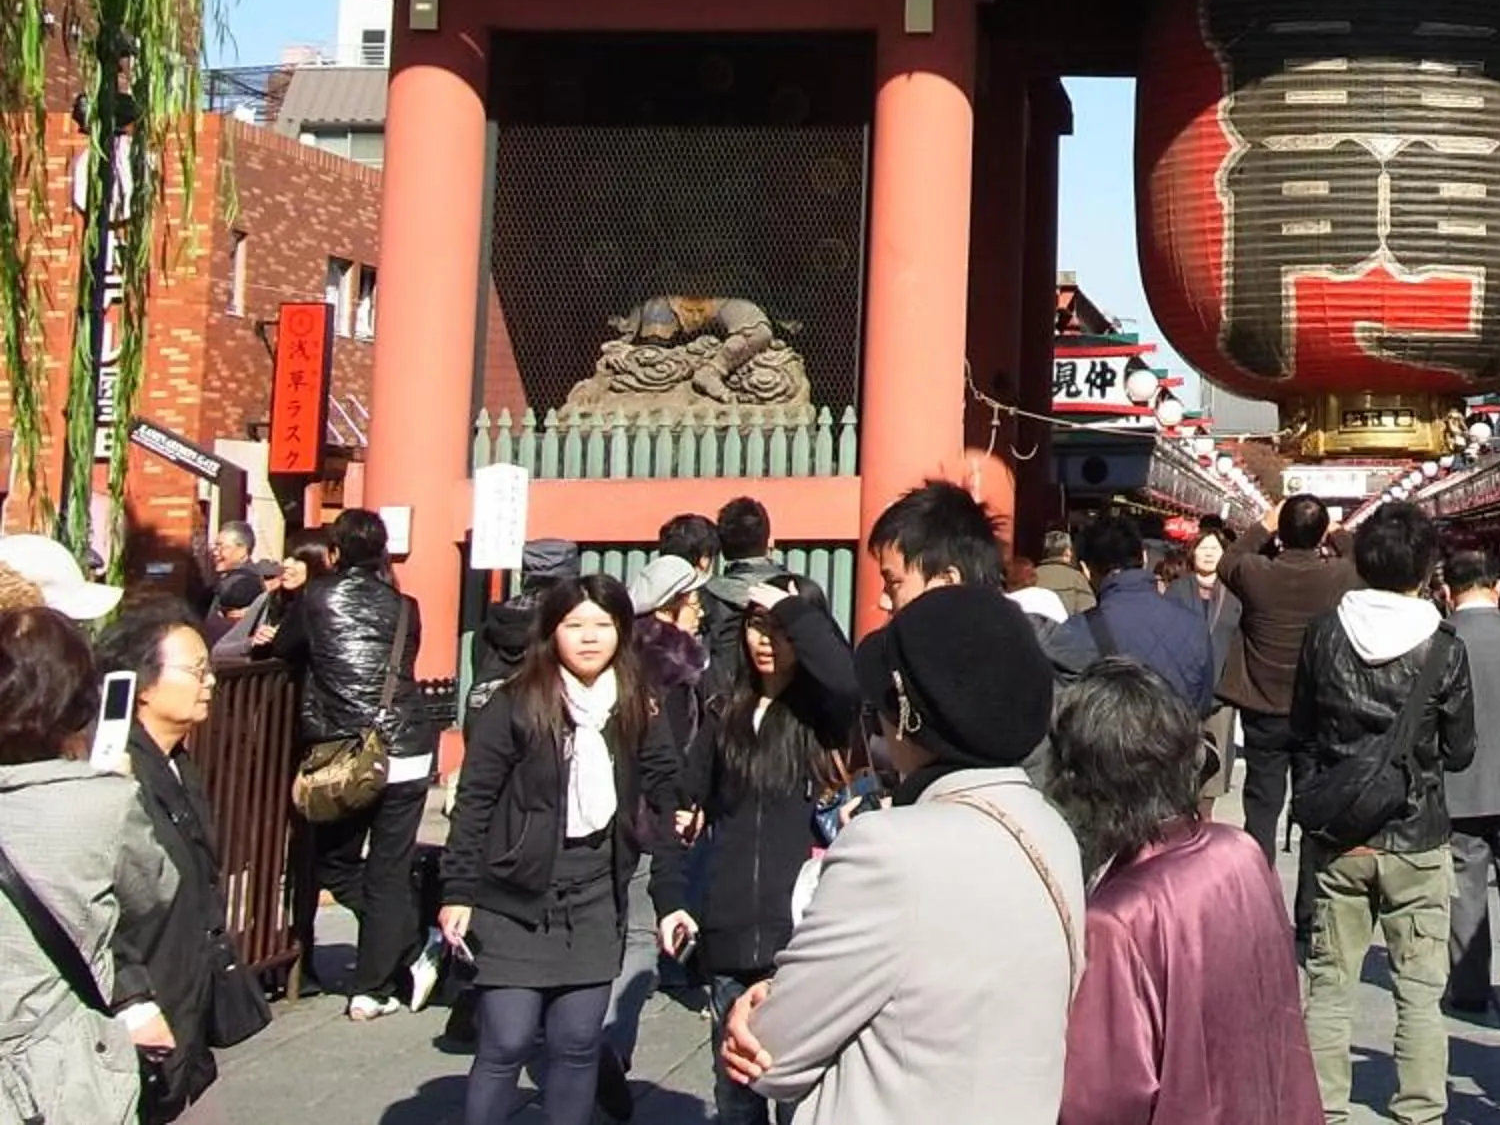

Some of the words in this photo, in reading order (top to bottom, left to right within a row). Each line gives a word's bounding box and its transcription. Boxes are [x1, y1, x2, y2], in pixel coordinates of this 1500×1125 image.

[284, 339, 310, 469] 浅草ラスク
